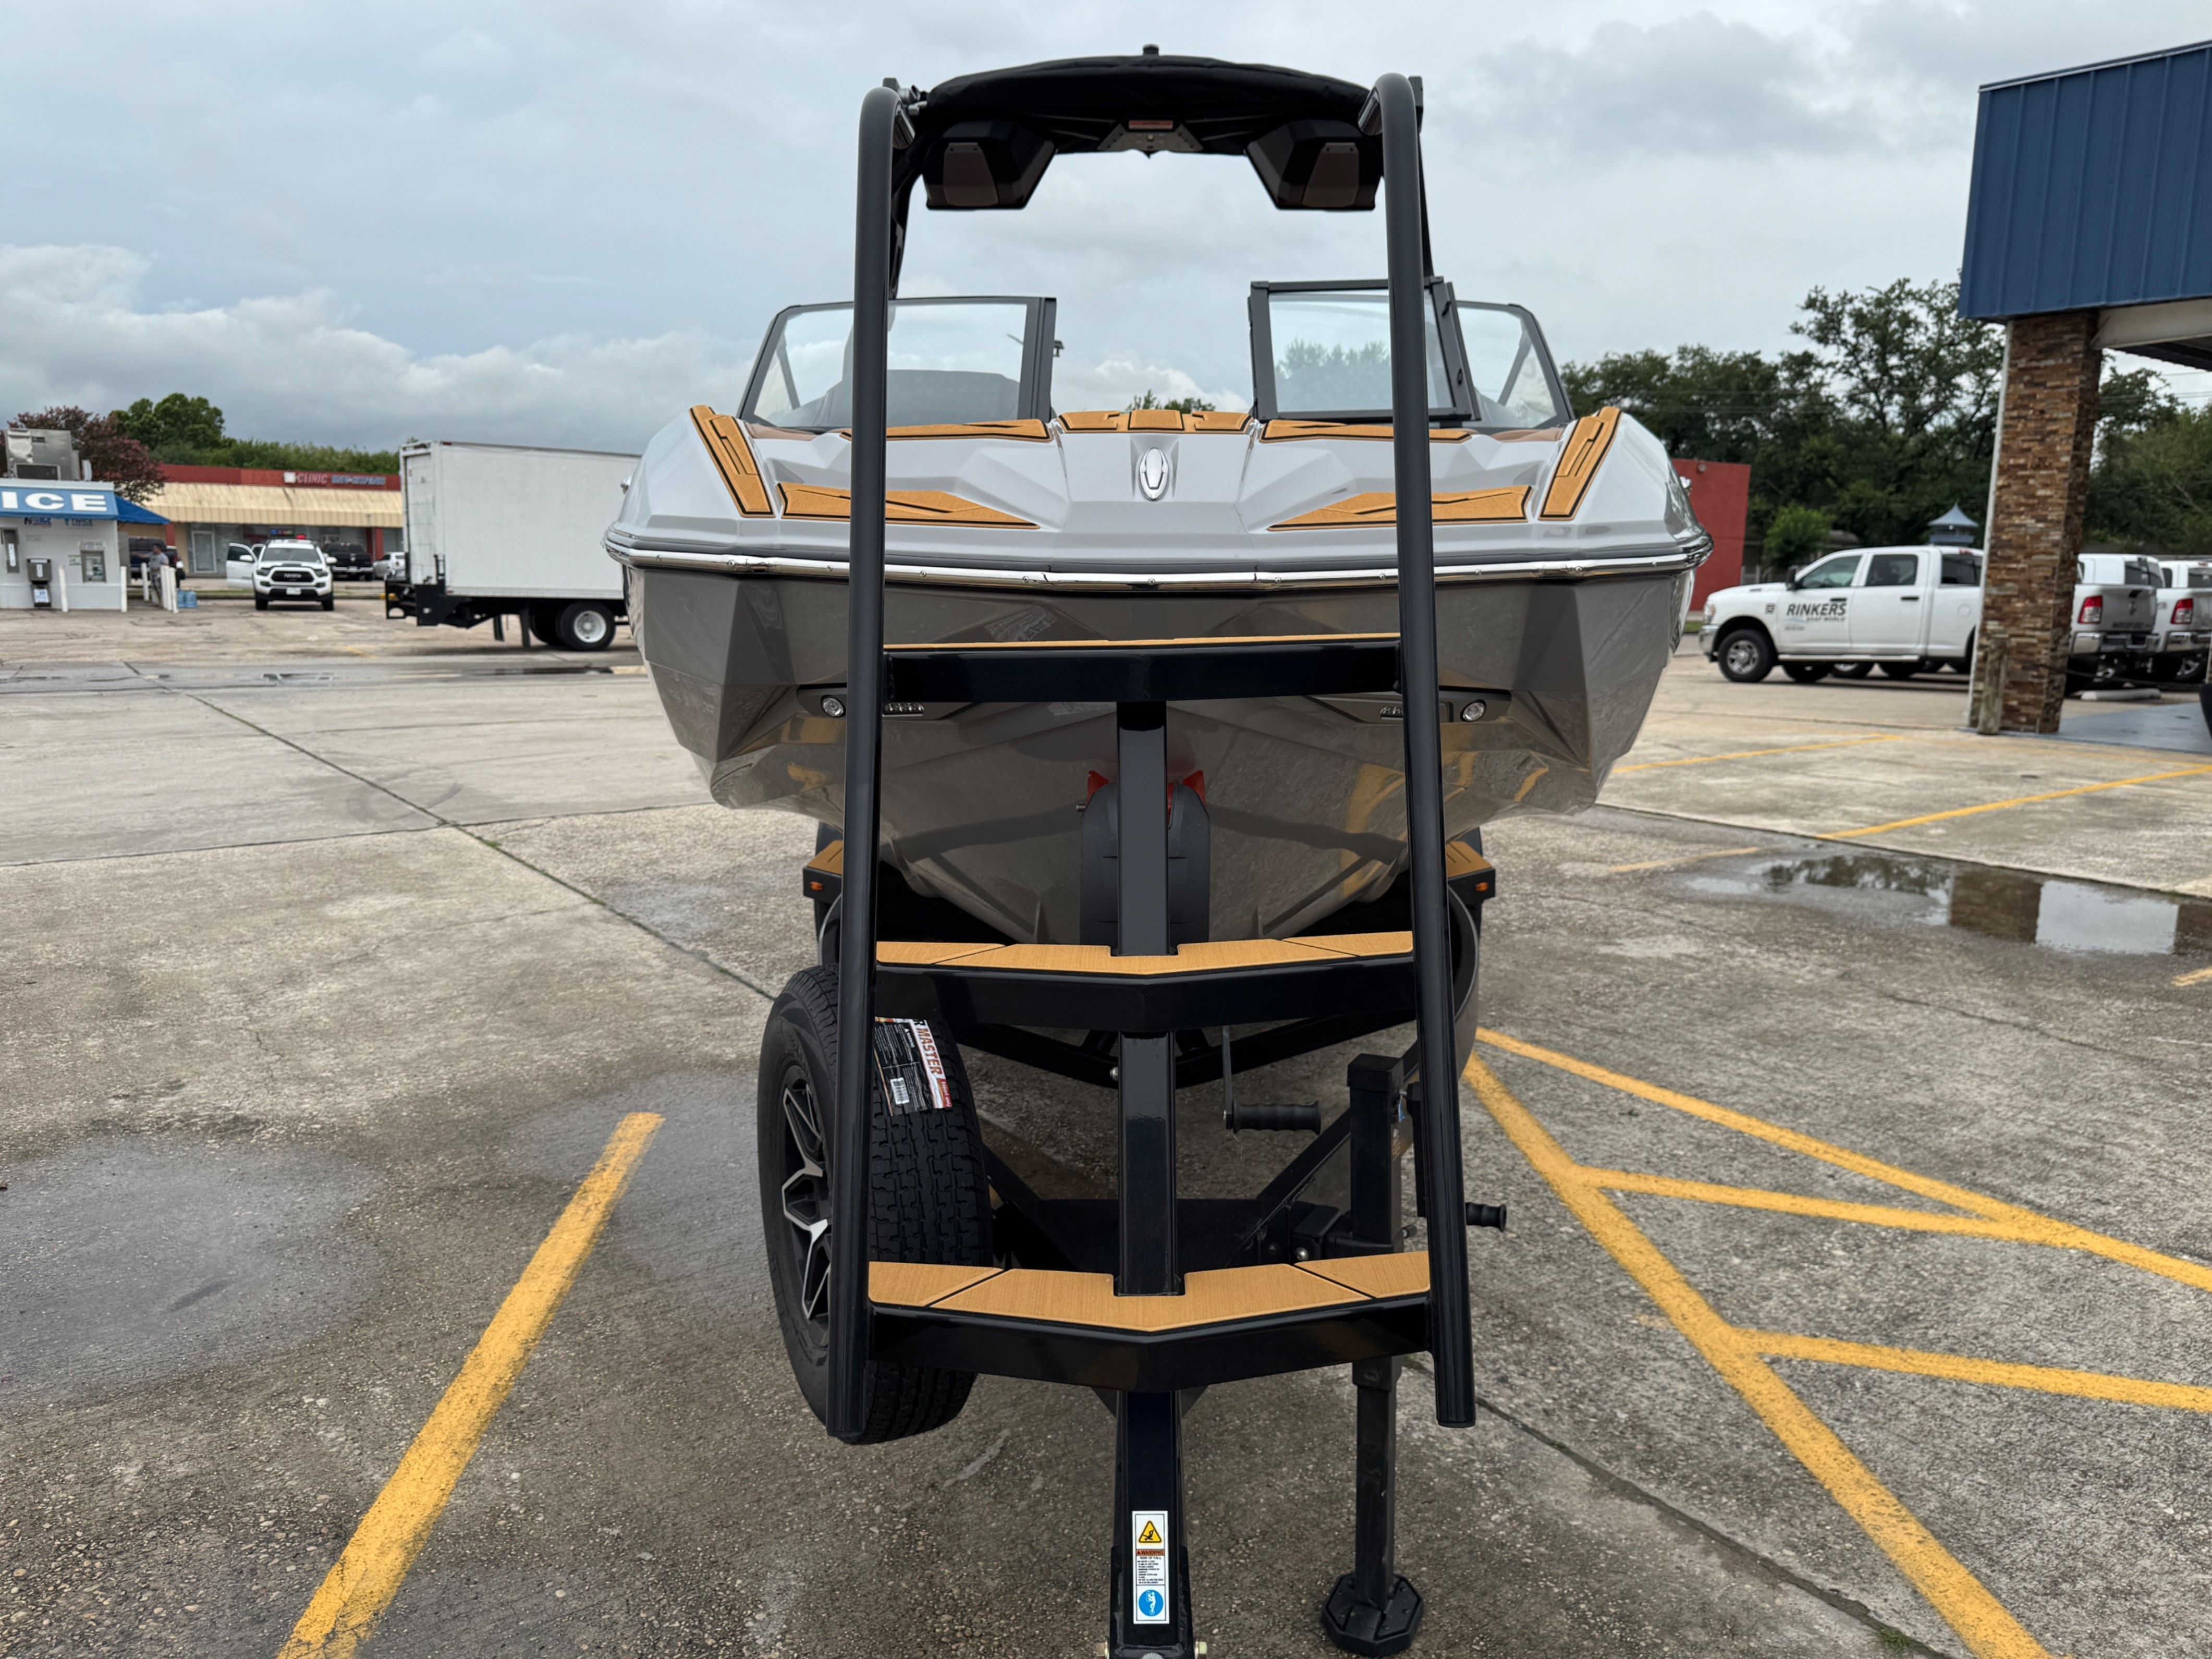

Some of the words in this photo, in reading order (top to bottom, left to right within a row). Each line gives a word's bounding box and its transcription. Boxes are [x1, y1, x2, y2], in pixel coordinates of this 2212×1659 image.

[298, 472, 327, 484] CLINIC
[2, 491, 107, 511] ICE
[1786, 603, 1847, 616] RINKERS
[916, 1028, 943, 1075] MASTER
